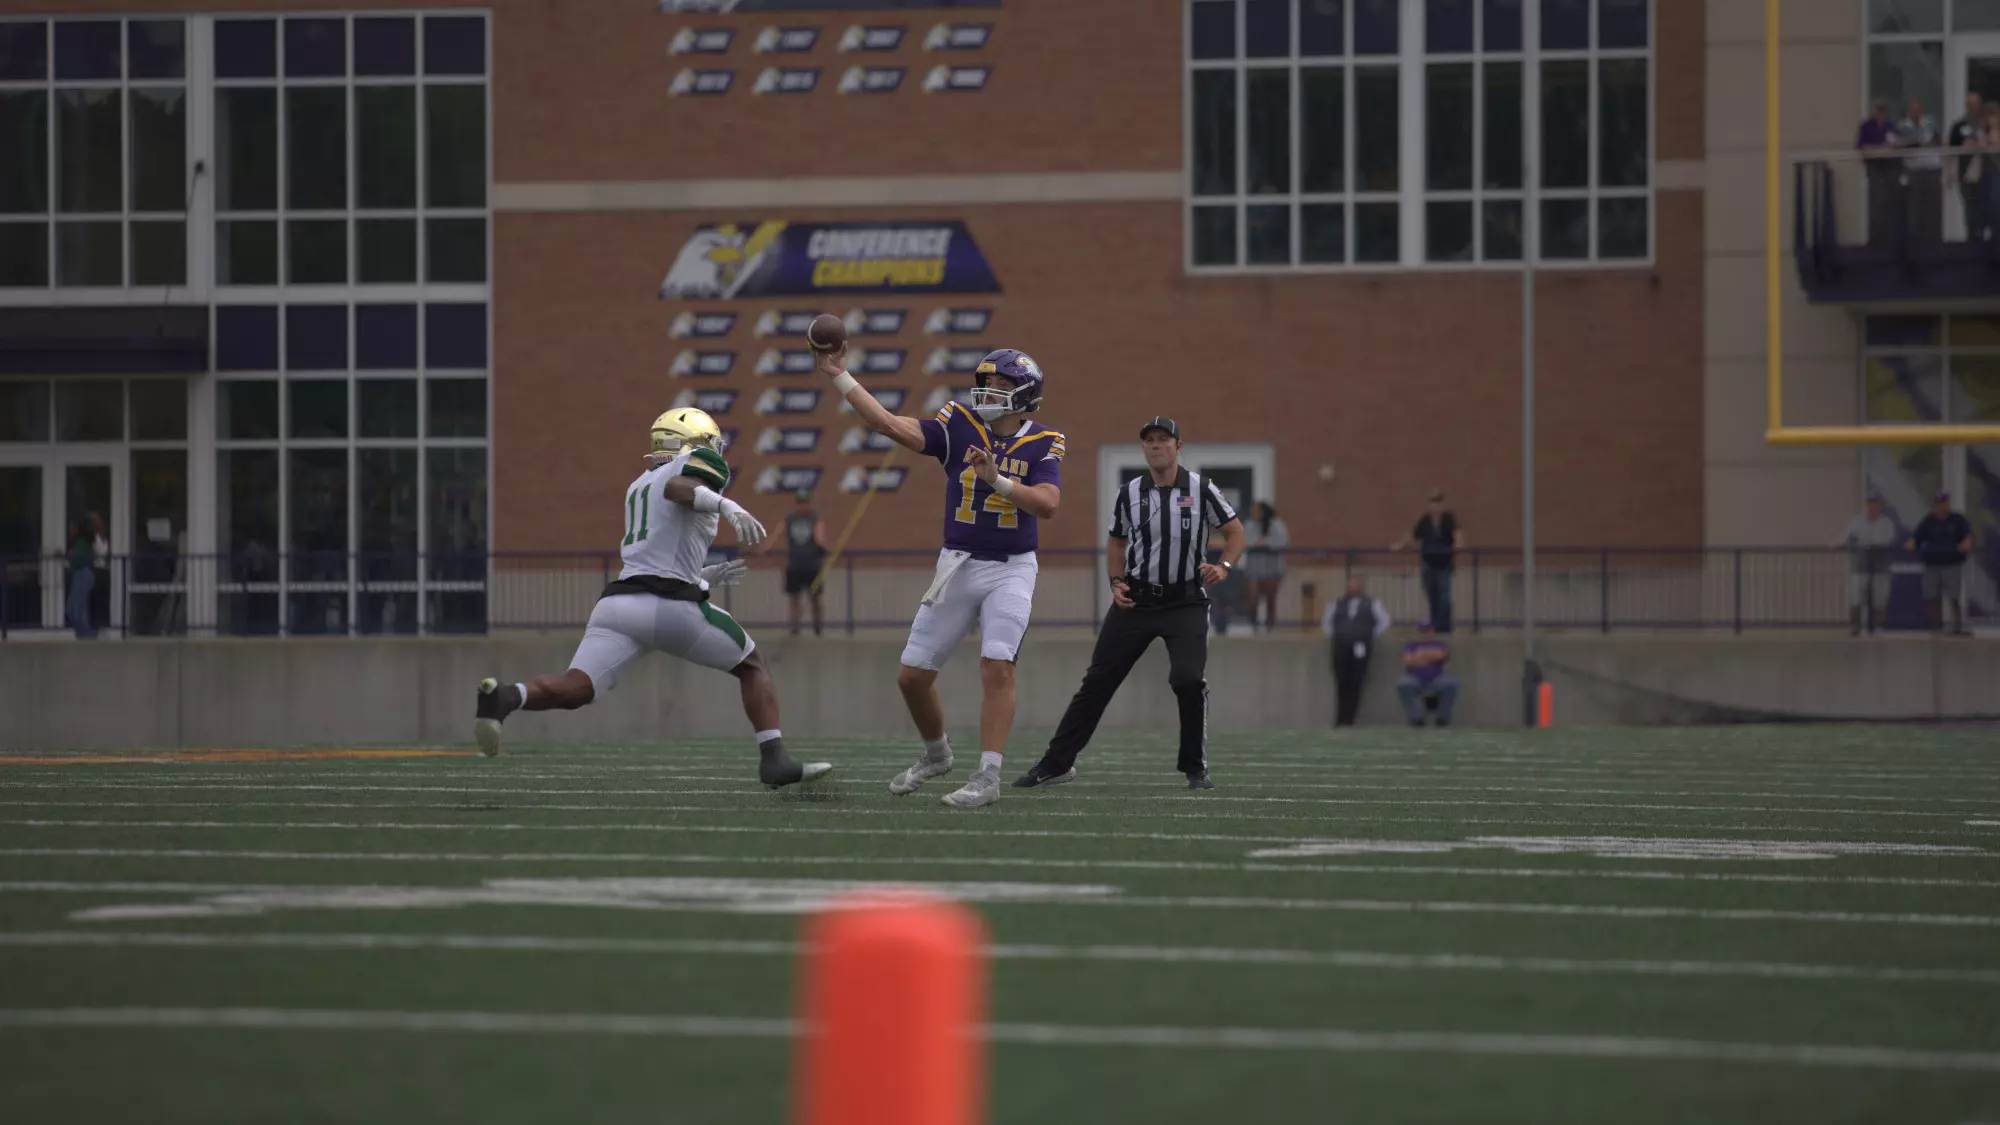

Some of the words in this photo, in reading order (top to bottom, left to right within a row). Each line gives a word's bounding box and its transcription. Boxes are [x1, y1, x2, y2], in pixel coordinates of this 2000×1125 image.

[806, 228, 952, 259] CONFERENCE
[811, 257, 947, 287] CHAMPIONS
[963, 447, 1029, 477] LAND
[954, 465, 1022, 529] 14
[623, 482, 652, 546] 11
[1181, 517, 1191, 530] U
